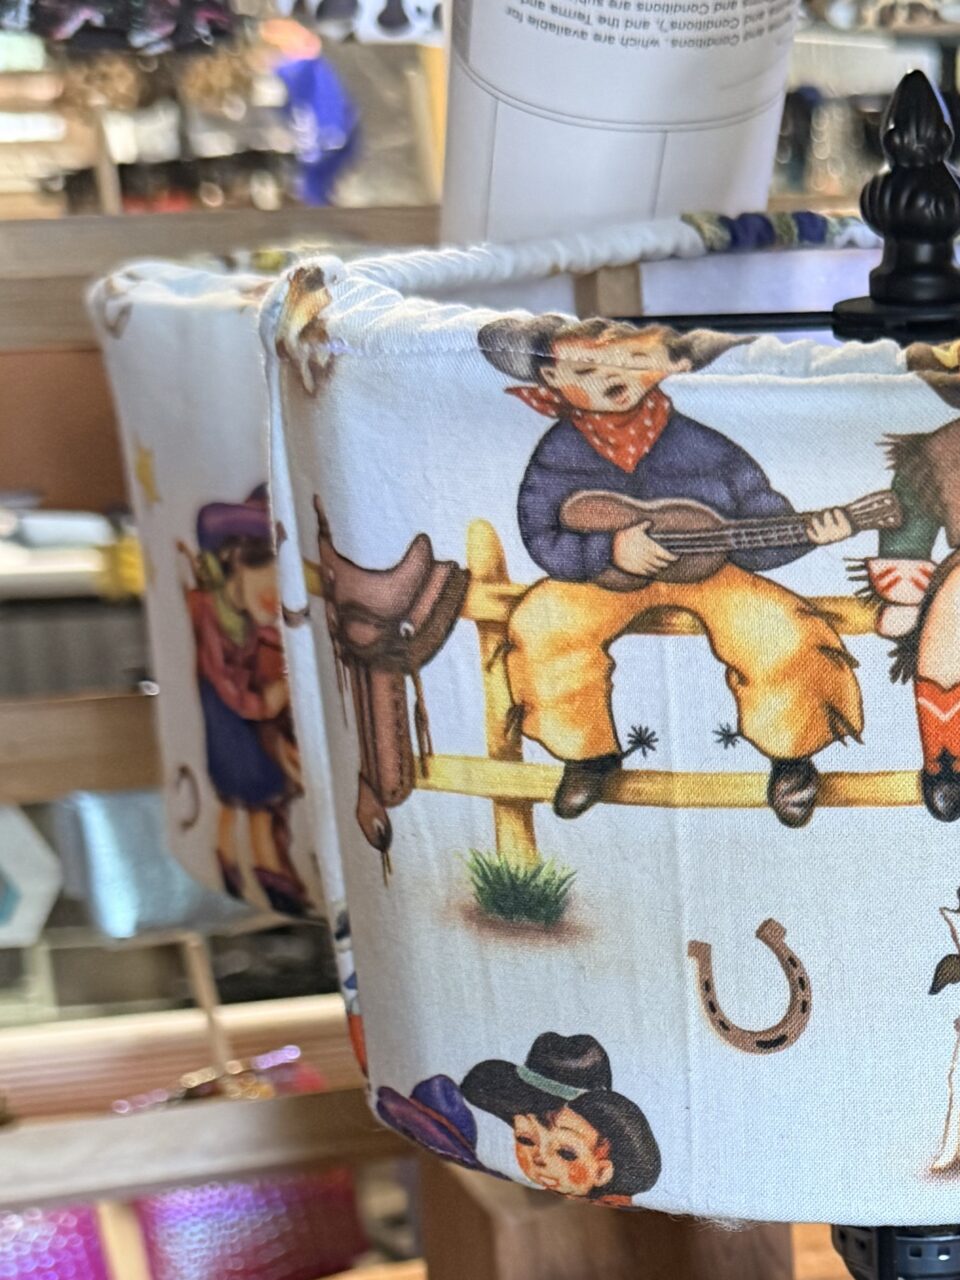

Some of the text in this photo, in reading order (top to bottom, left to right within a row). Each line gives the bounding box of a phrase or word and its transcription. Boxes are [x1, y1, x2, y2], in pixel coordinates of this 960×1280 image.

[526, 14, 589, 41] available
[597, 14, 620, 29] the
[624, 17, 651, 31] and
[592, 33, 616, 44] are
[620, 36, 660, 49] which
